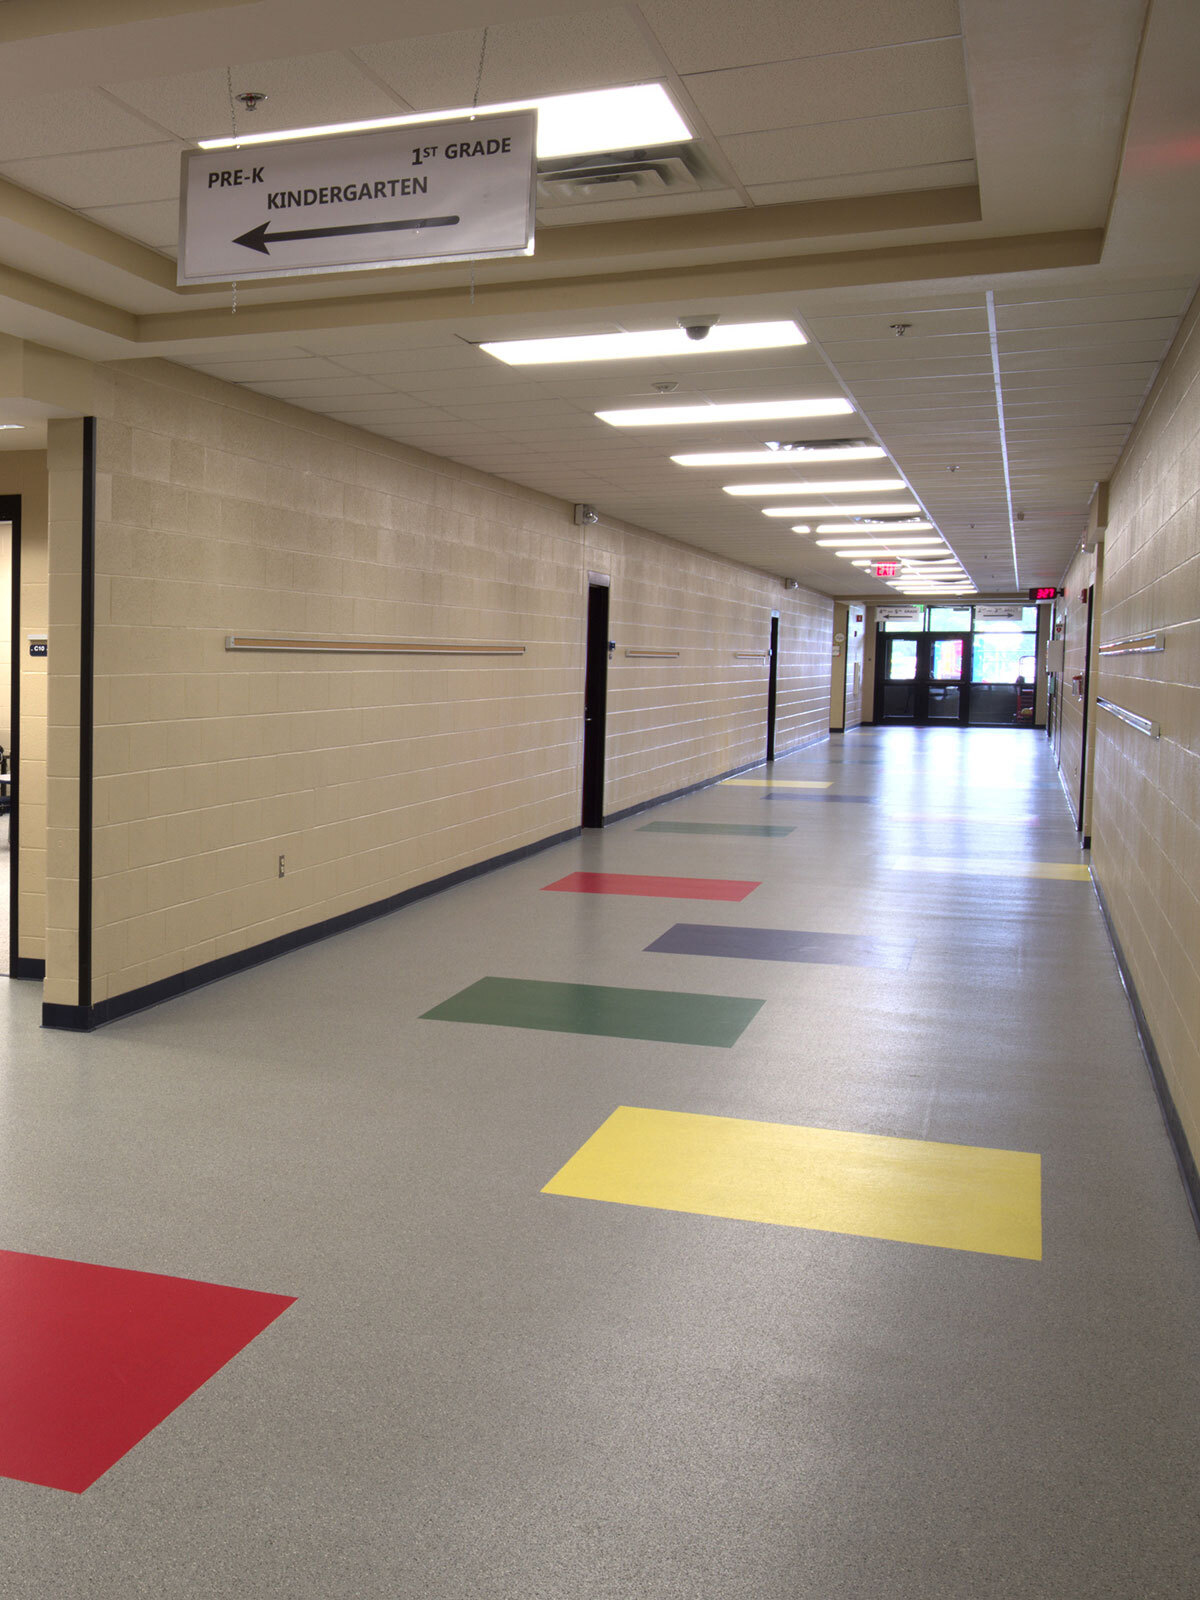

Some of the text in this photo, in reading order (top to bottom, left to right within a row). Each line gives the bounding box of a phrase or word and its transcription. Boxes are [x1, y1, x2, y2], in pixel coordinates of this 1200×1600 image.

[411, 137, 512, 166] 1ST GRADE
[207, 166, 265, 189] PRE-K
[266, 176, 429, 211] KINDERGARTEN
